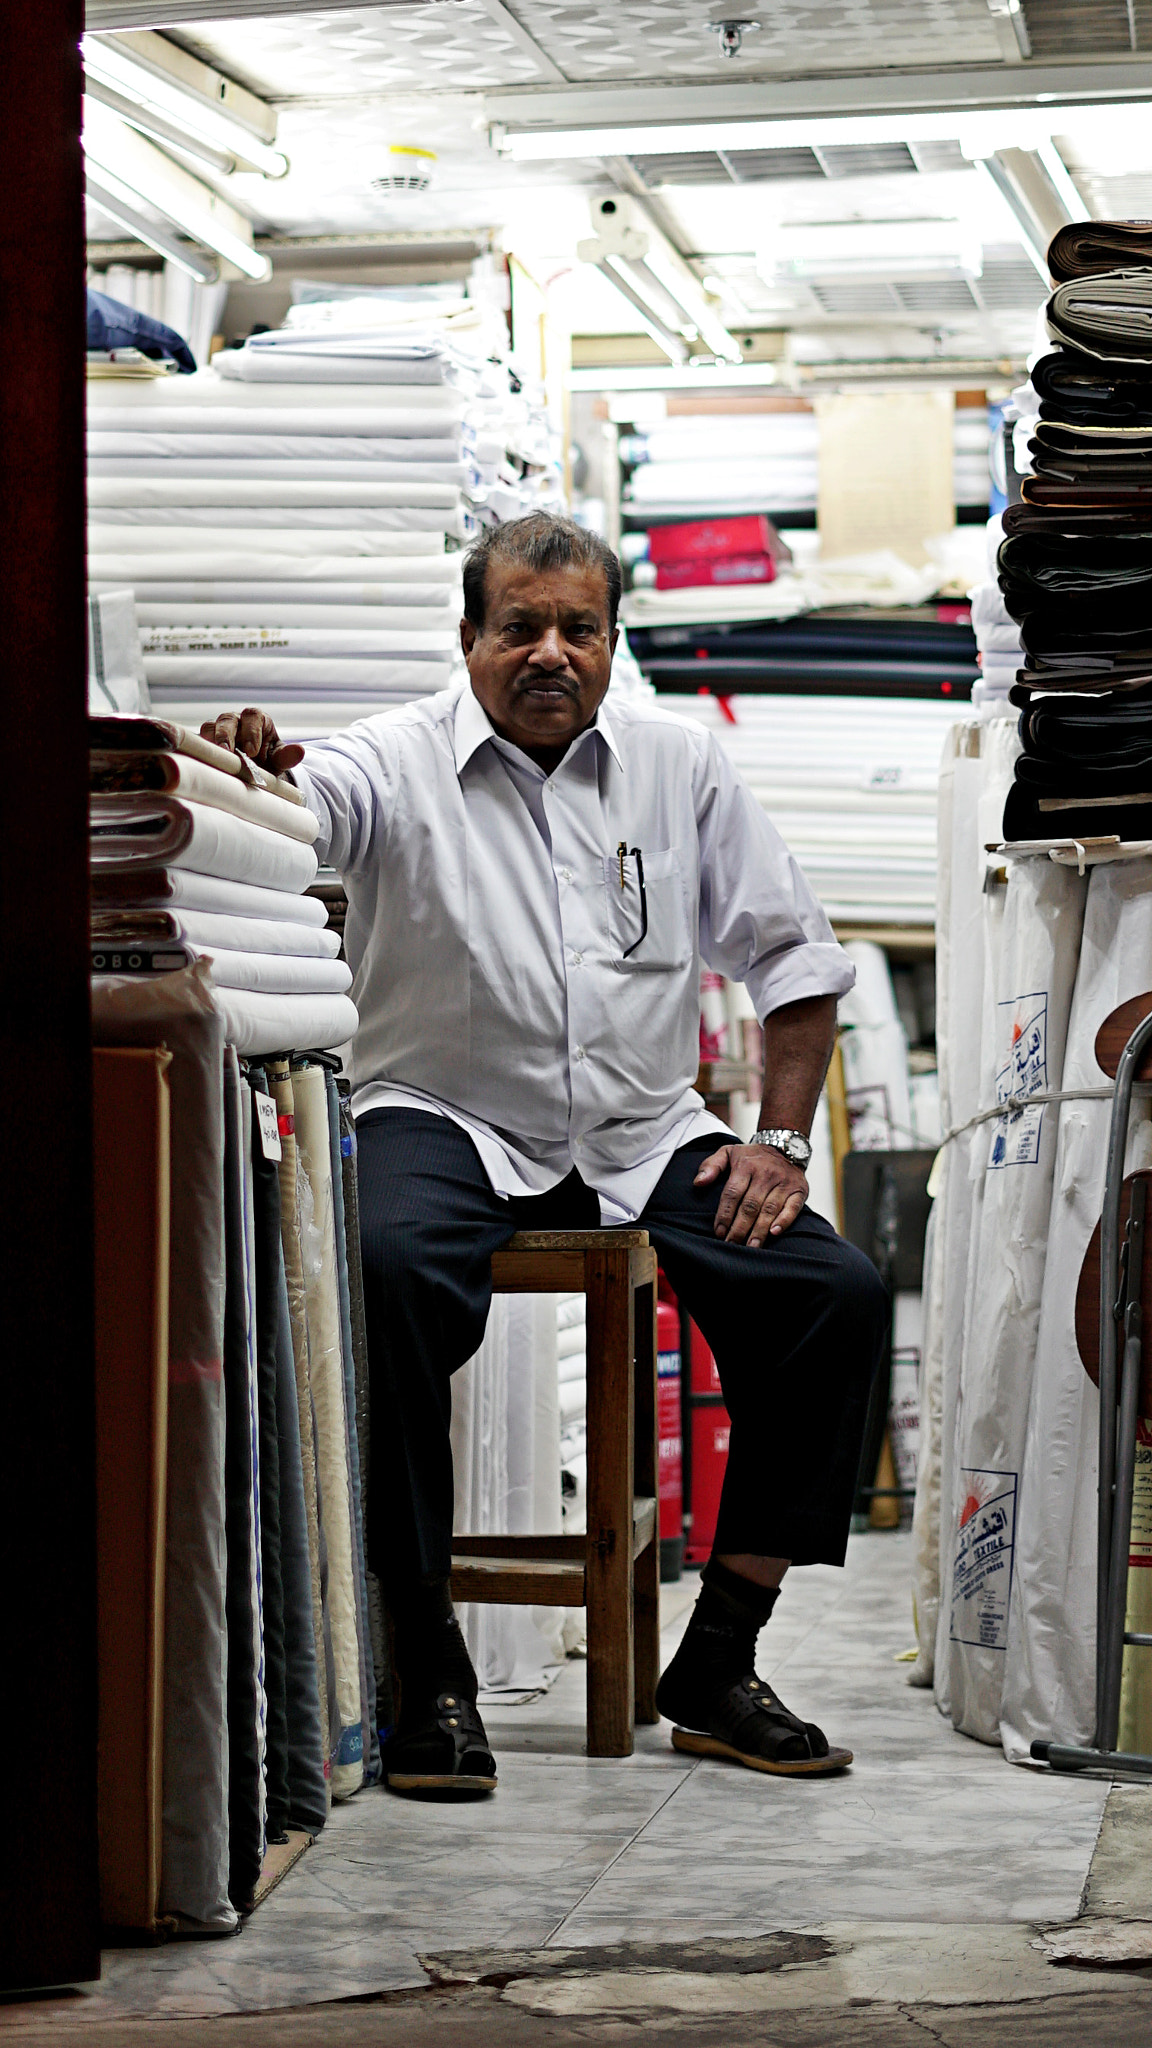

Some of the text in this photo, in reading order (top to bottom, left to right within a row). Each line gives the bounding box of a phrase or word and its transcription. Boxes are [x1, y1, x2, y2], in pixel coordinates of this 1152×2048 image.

[219, 641, 245, 650] MADE
[247, 641, 258, 649] IN
[260, 640, 289, 649] JAPAN
